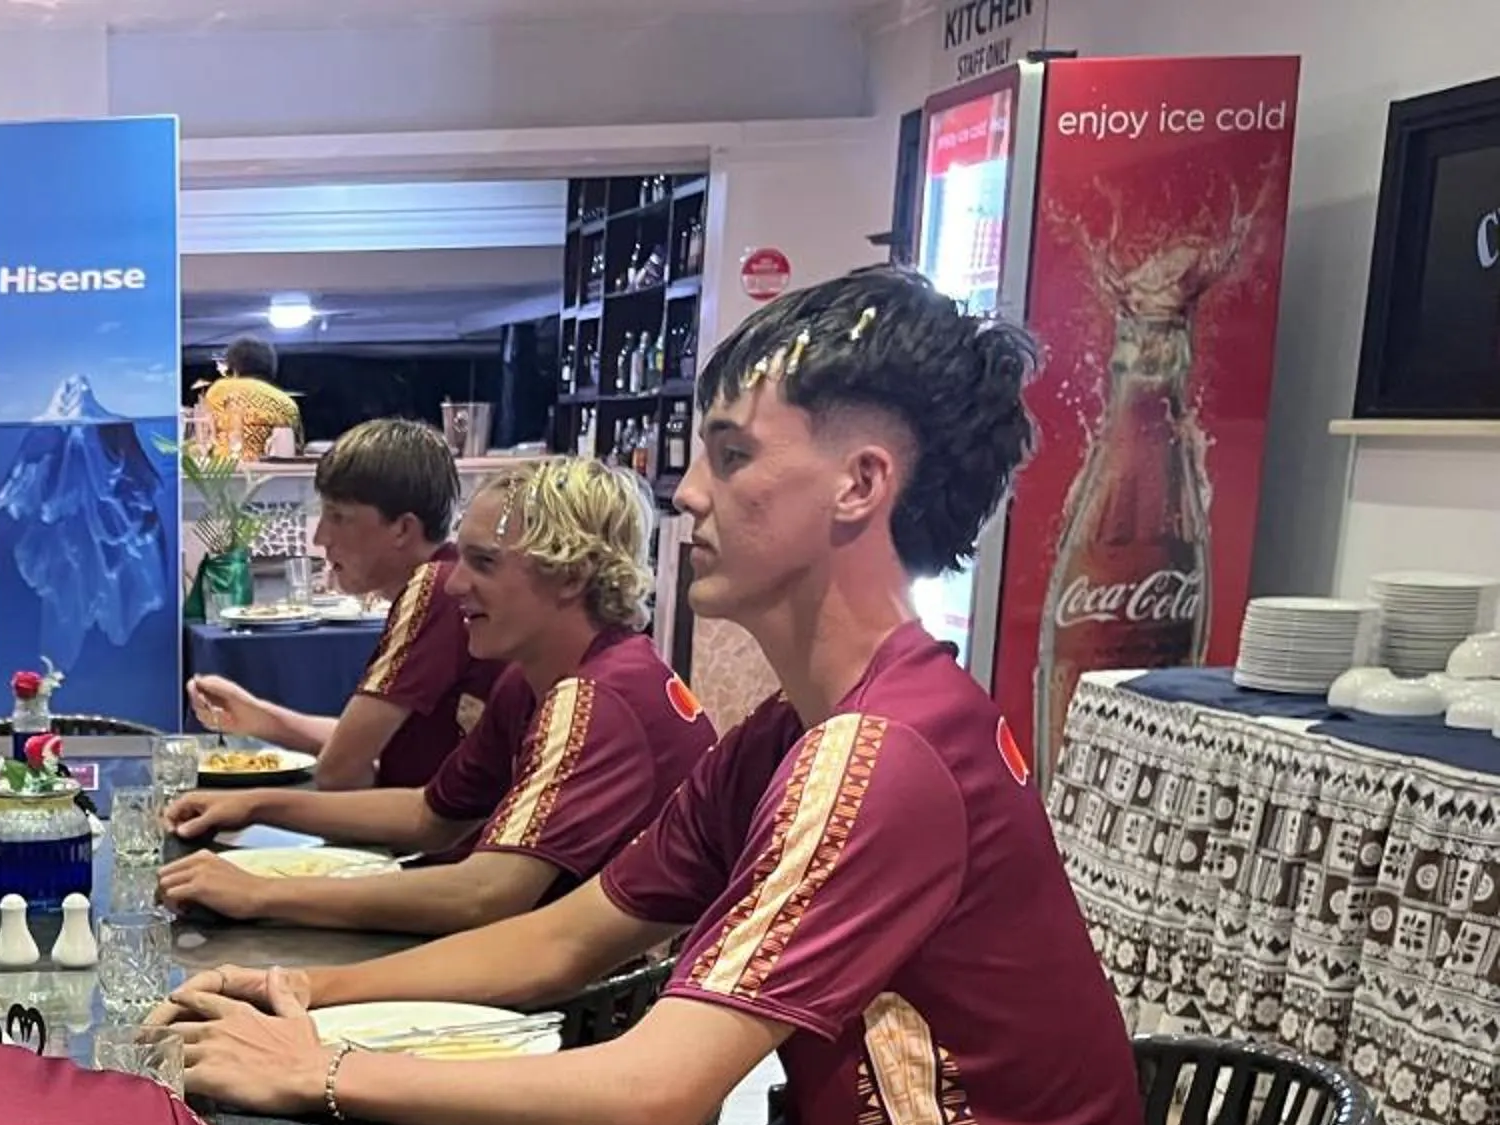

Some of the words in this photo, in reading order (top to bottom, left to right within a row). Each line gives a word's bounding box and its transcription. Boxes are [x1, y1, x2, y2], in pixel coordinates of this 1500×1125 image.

[944, 0, 1032, 51] KITCHEN
[1057, 103, 1149, 140] enjoy
[1158, 103, 1206, 132] ice
[1215, 102, 1286, 131] cold
[1056, 569, 1203, 628] Coca-Cola
